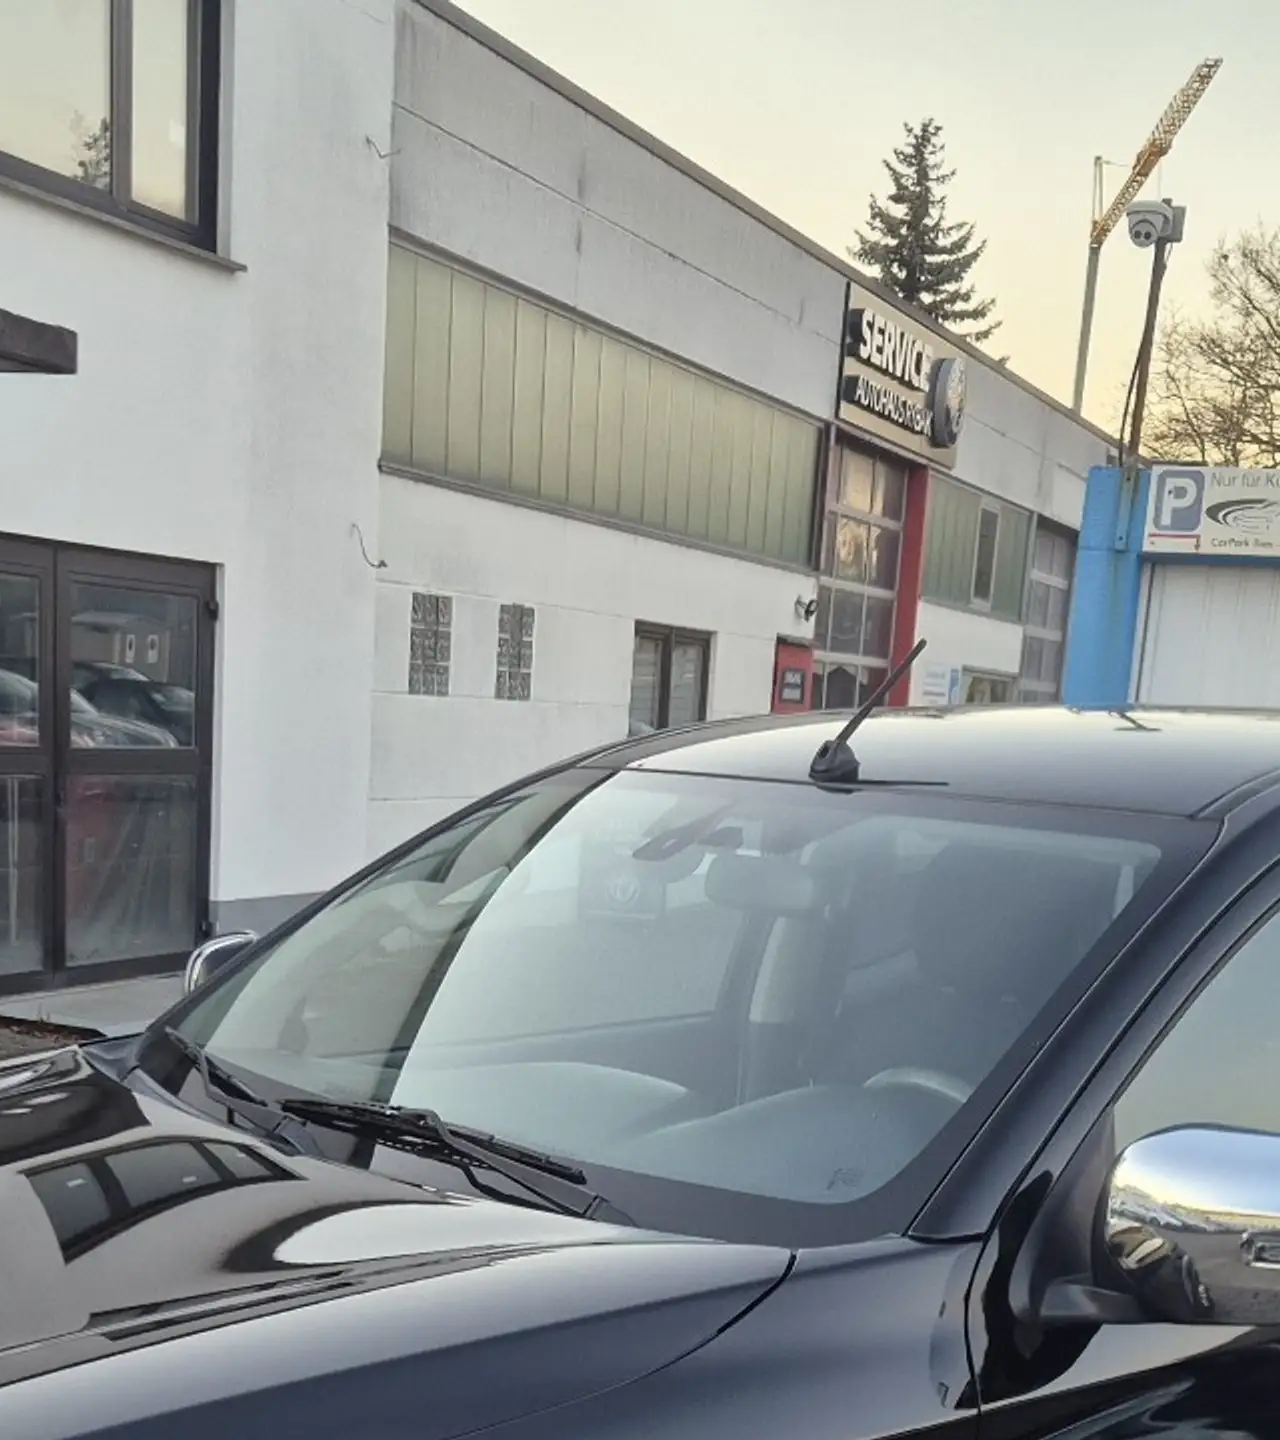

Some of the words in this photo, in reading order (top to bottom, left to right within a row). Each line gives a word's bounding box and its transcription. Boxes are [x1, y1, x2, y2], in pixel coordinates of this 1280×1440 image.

[859, 307, 934, 392] SERVICE
[1211, 473, 1237, 488] Nur
[1241, 472, 1262, 488] für
